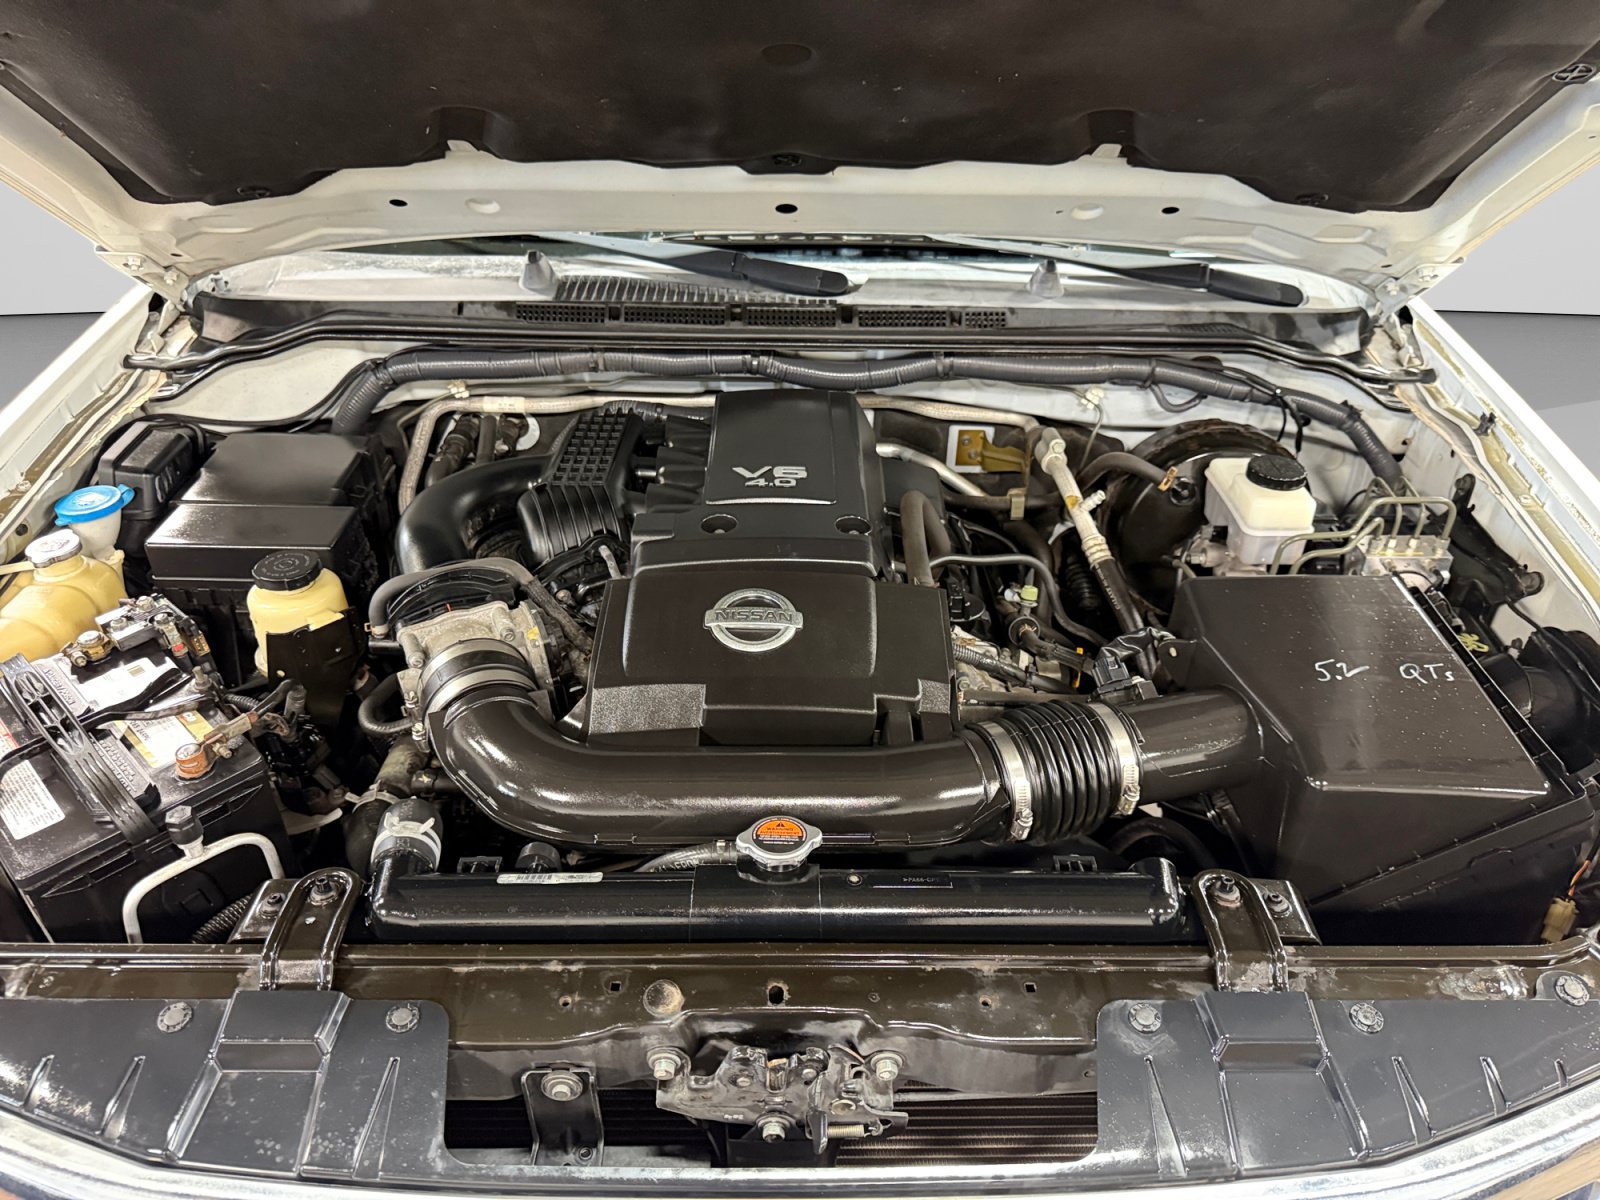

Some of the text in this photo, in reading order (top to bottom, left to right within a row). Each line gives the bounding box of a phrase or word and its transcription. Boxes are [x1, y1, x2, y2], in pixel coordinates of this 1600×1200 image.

[732, 465, 808, 479] V6
[744, 477, 797, 488] 4.0
[714, 608, 794, 624] NISSAN
